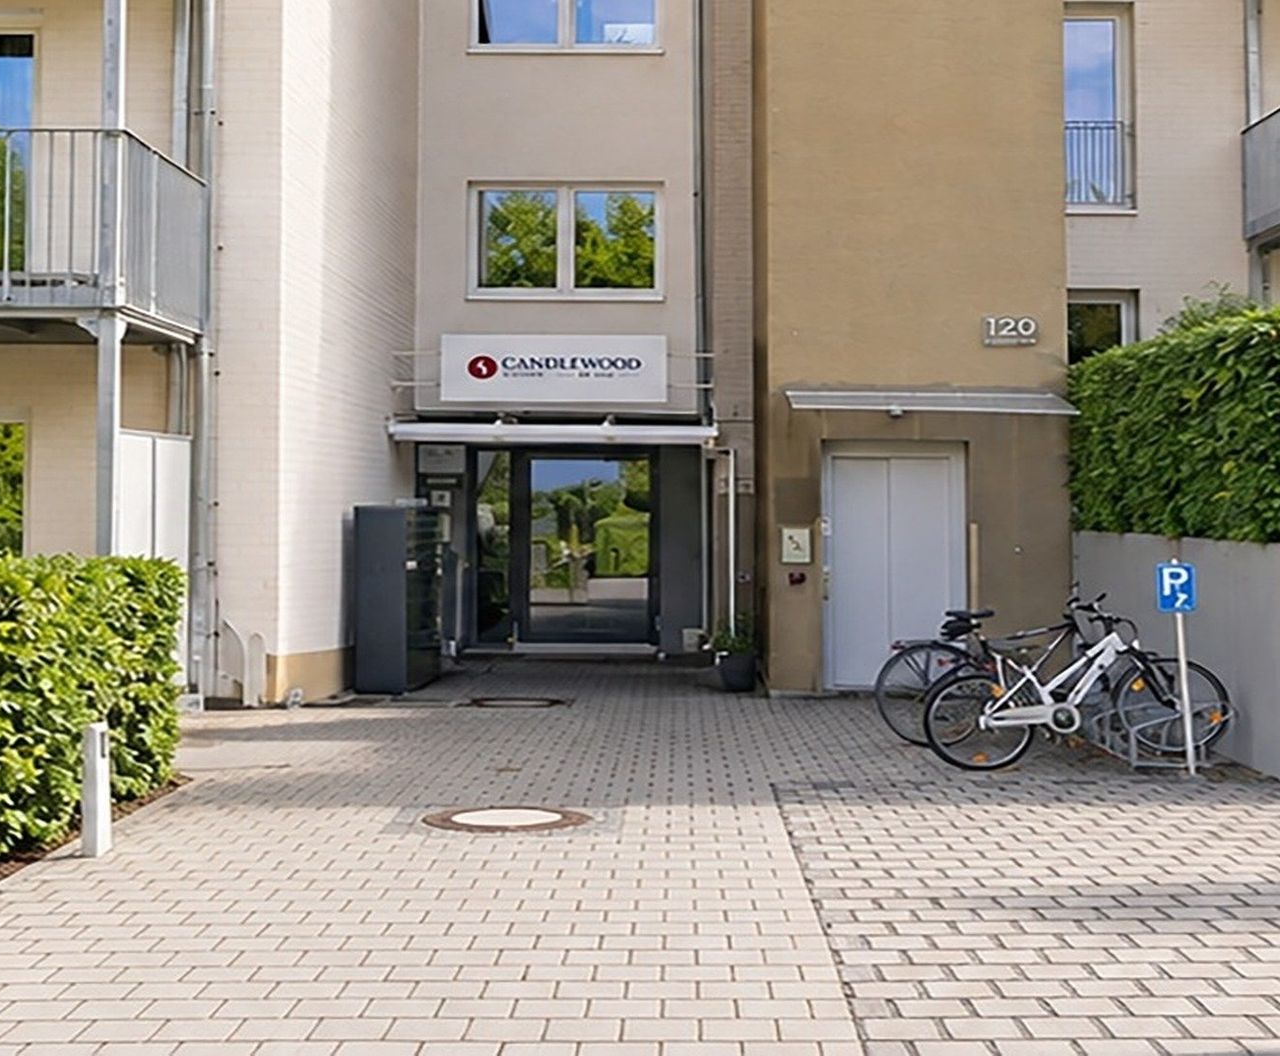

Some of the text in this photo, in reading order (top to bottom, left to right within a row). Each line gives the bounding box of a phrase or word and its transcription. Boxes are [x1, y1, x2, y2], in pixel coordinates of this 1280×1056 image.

[985, 318, 1036, 336] 120
[501, 356, 642, 371] CANDLEWOOD
[1162, 567, 1189, 596] P
